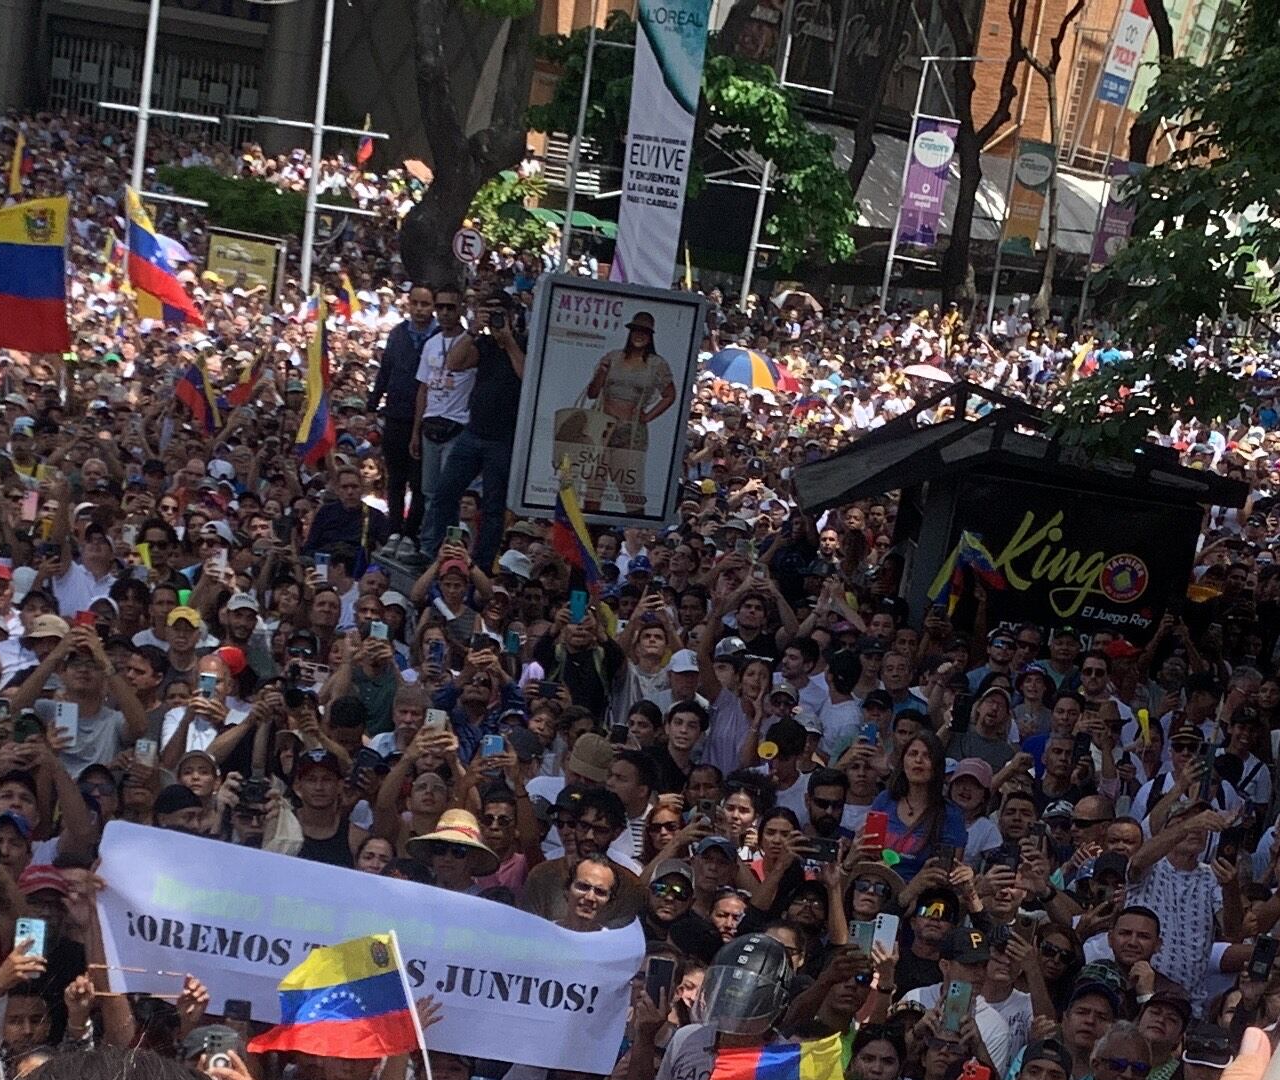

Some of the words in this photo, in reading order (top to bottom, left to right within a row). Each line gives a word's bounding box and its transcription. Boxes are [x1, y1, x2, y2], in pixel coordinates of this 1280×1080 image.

[630, 143, 686, 172] ELVIVE
[635, 171, 681, 186] ENCUENTRA
[461, 233, 476, 256] E
[558, 294, 624, 317] MYSTIC
[578, 450, 608, 466] SML
[995, 510, 1106, 618] King
[1081, 605, 1092, 618] El
[1094, 608, 1128, 625] Juego
[1130, 613, 1153, 630] Rey
[126, 911, 293, 967] ¡OREMOS
[970, 932, 982, 949] P
[435, 963, 600, 1015] JUNTOS!
